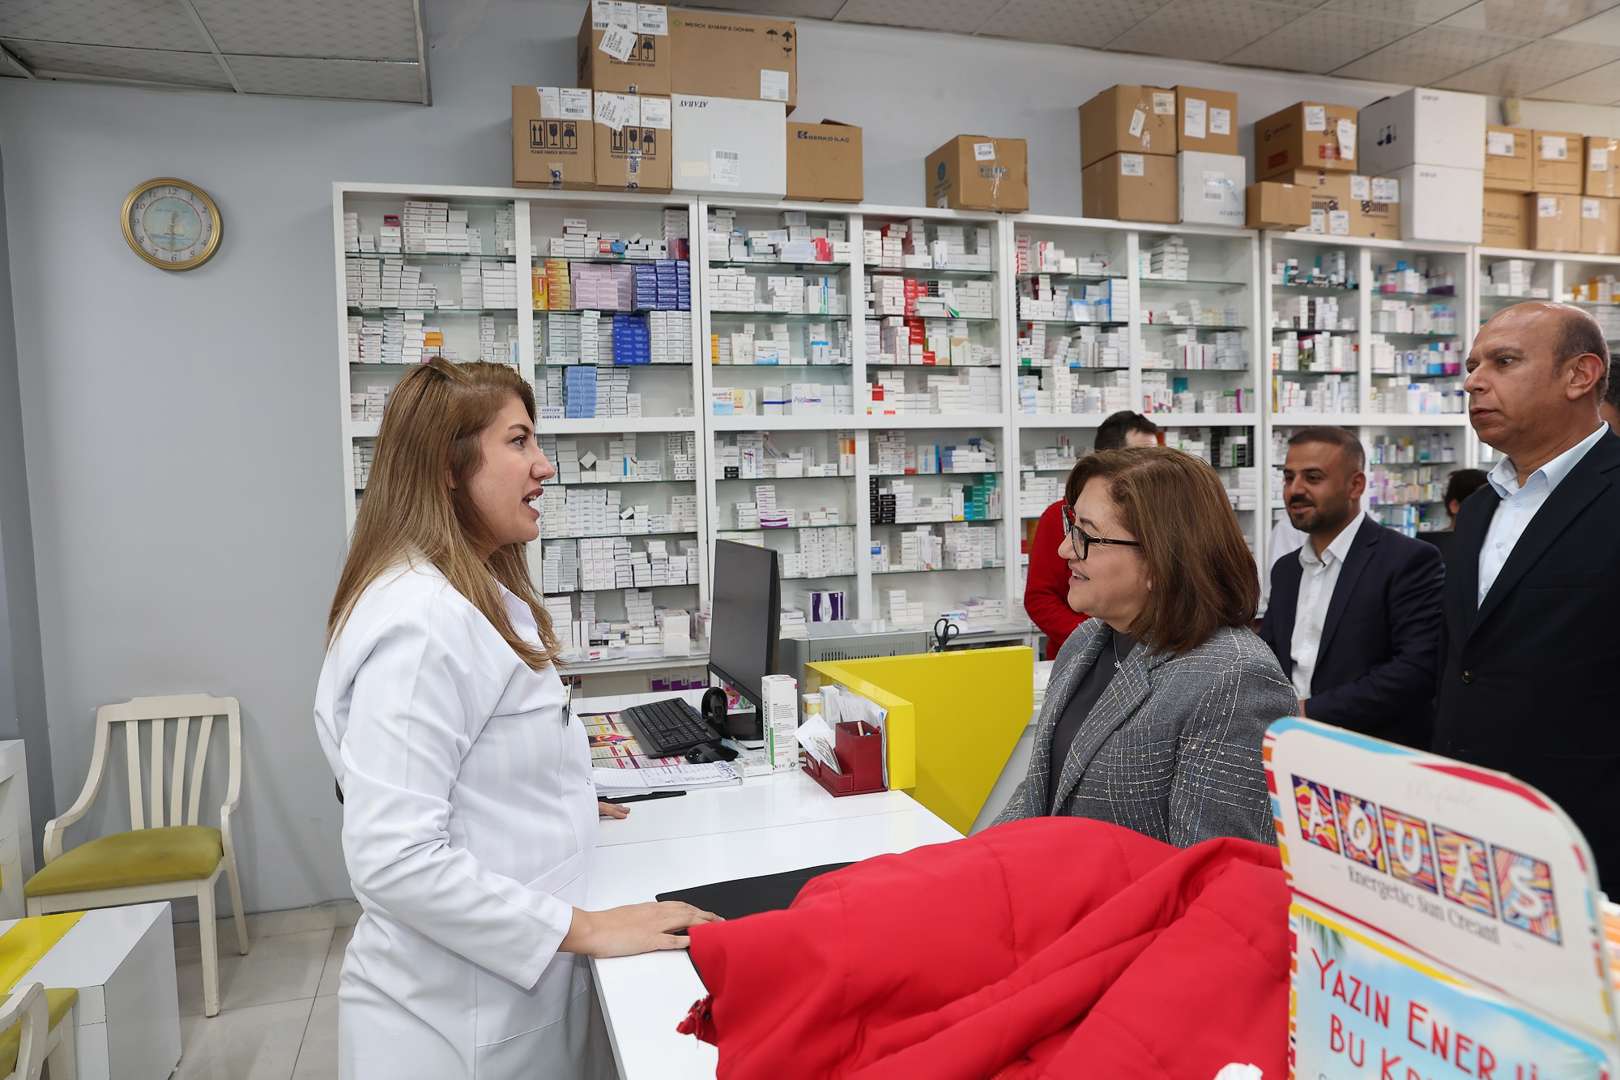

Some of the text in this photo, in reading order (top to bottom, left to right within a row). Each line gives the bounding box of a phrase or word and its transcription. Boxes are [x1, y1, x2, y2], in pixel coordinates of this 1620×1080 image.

[1299, 781, 1556, 933] AQUAS
[1348, 864, 1500, 944] Energetic Sun Cream
[1311, 947, 1390, 1030] YAZIN
[1330, 1013, 1366, 1068] BU
